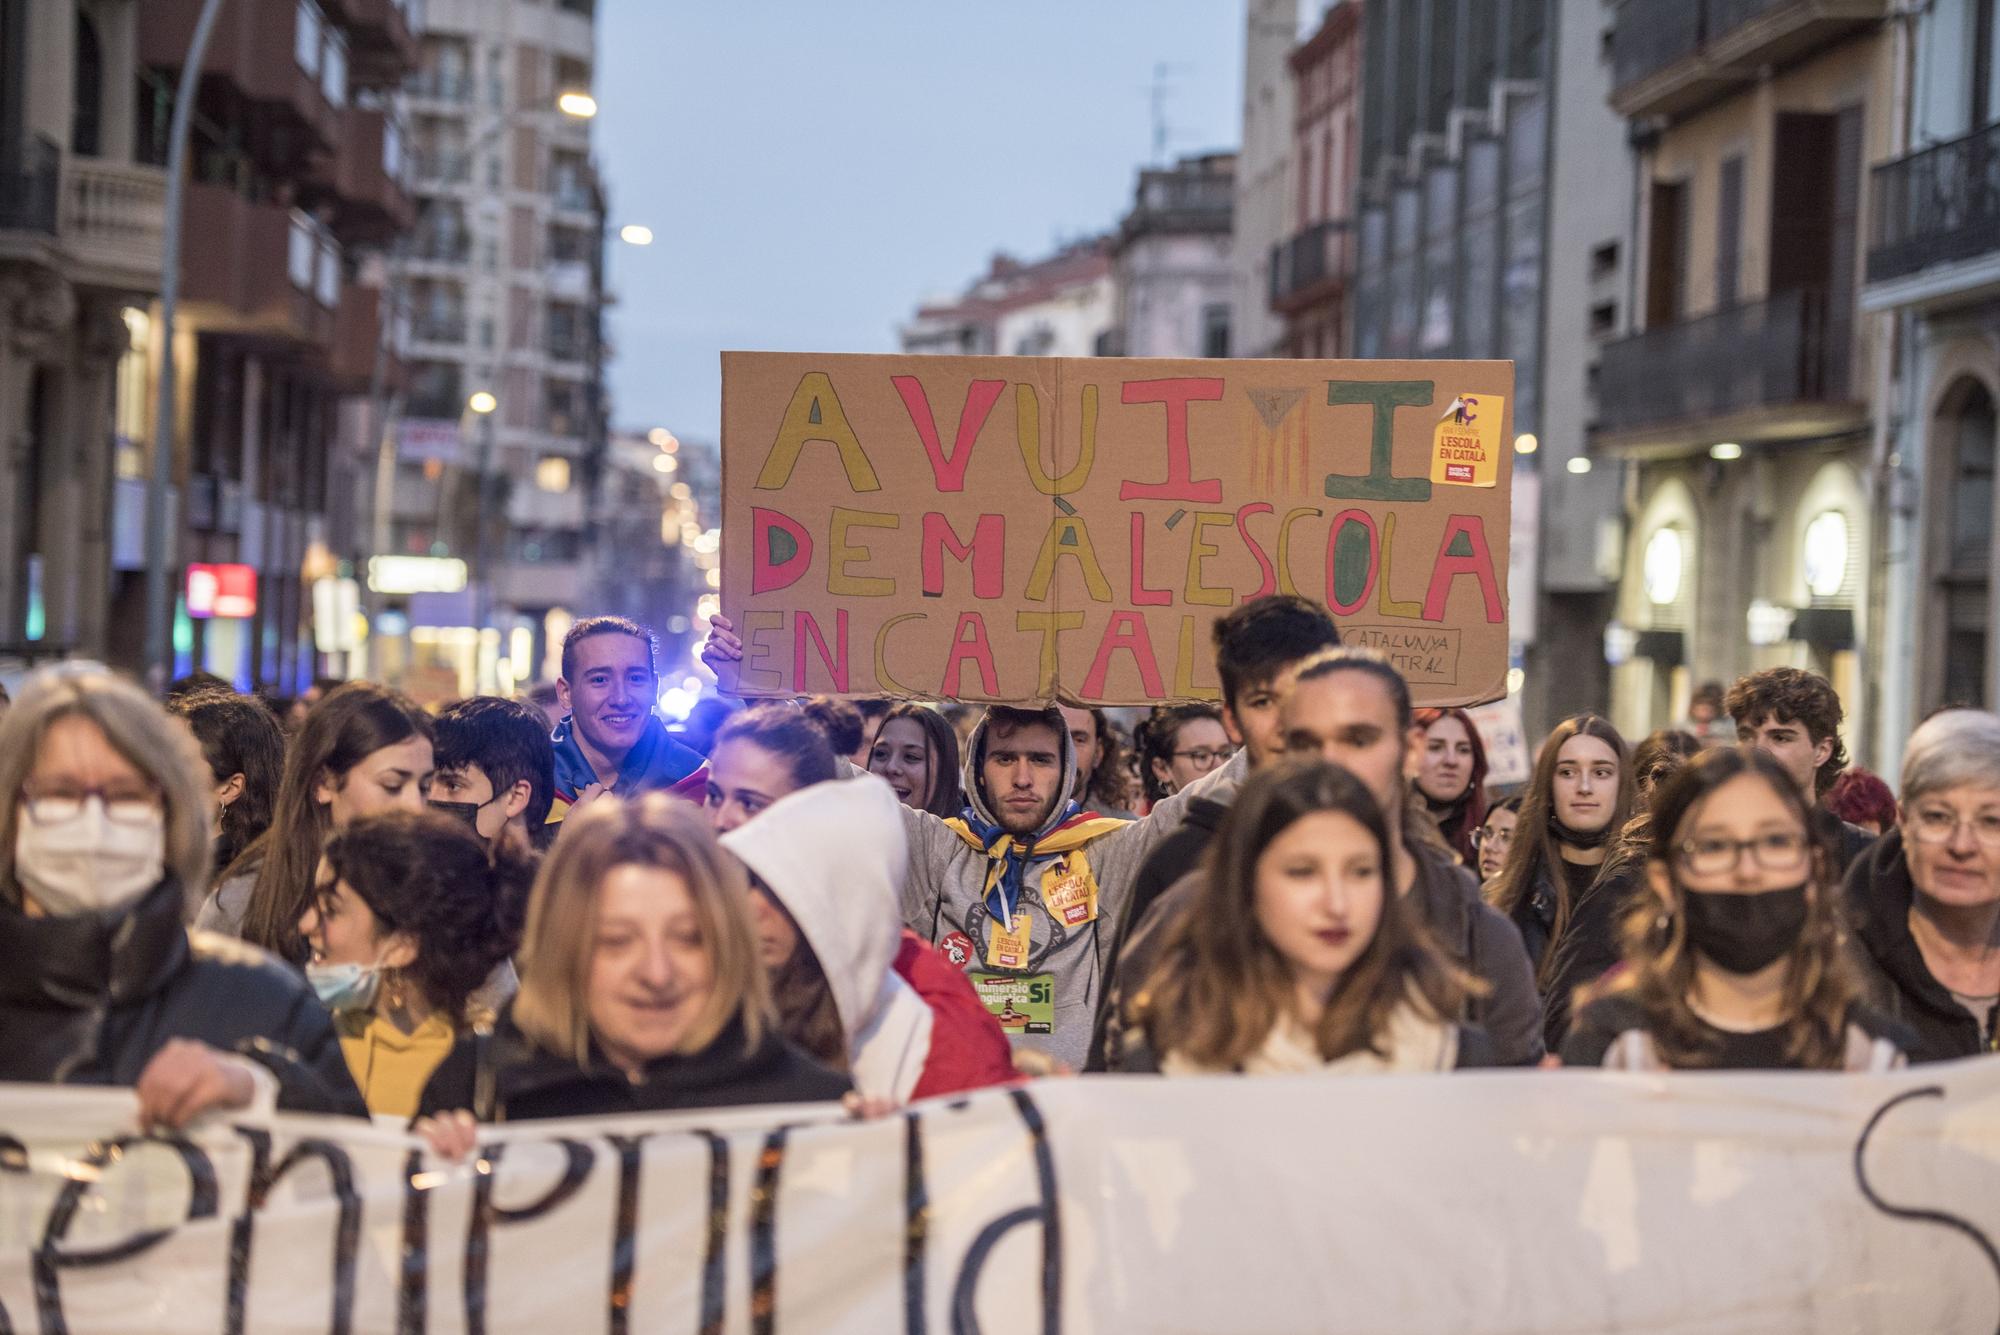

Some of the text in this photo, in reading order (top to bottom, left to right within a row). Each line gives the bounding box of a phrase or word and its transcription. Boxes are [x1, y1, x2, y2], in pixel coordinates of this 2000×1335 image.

[753, 371, 1435, 504] AVUI I
[1441, 437, 1481, 449] L'ESCOLA
[1440, 448, 1486, 462] EN CATALÀ
[751, 496, 1505, 624] DEMÀ L'ESCOLA
[1343, 628, 1449, 654] CATALUNYA
[737, 607, 1222, 700] EN CATAL
[1391, 653, 1446, 674] TRAL
[974, 982, 1051, 1003] Immersió Sí
[980, 994, 1028, 1005] ngüística
